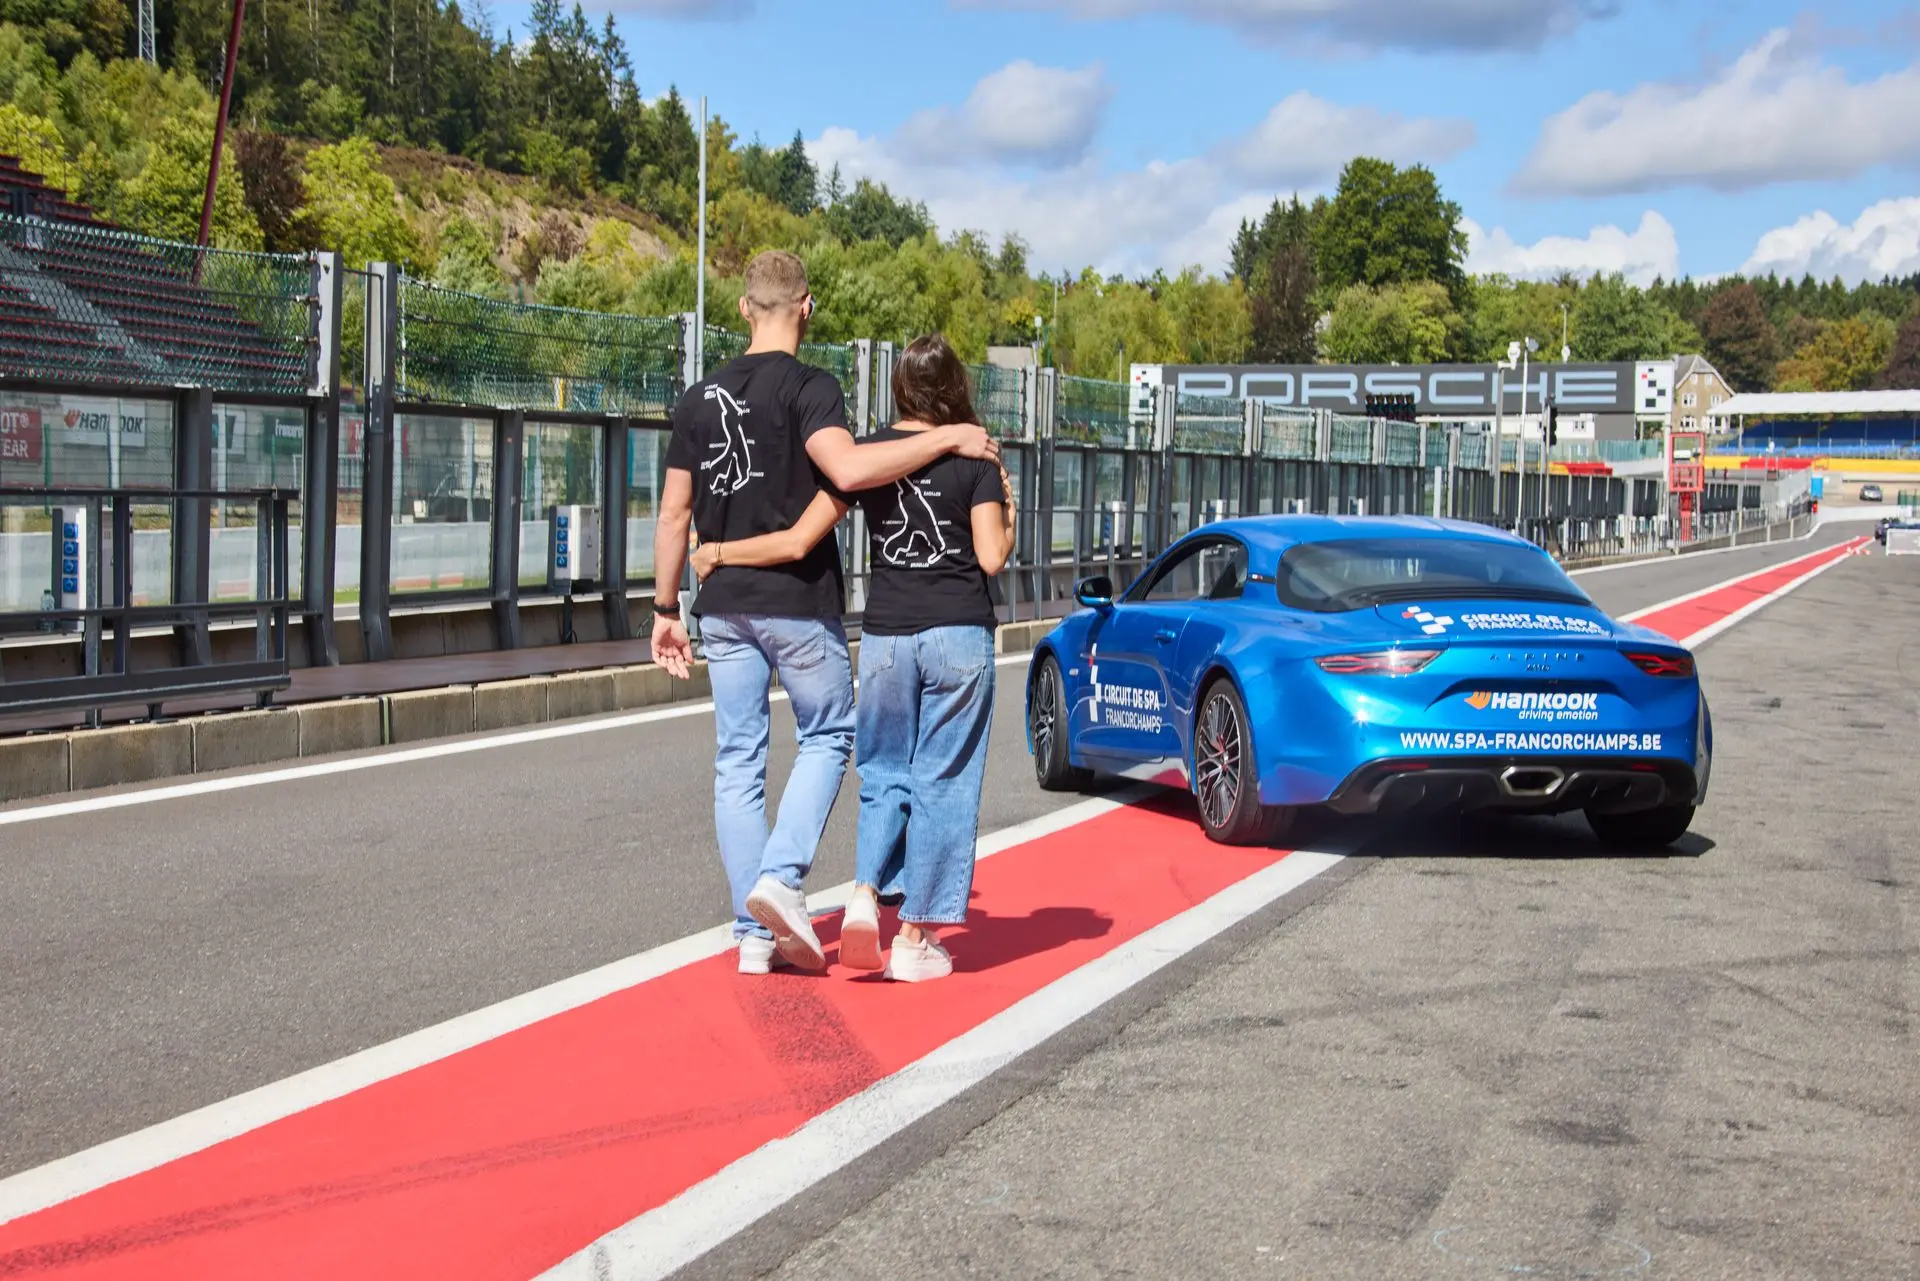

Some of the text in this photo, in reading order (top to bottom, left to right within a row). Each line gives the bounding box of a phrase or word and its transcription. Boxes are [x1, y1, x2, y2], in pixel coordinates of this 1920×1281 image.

[1178, 370, 1617, 405] PORSCHE
[80, 412, 143, 434] Hanook
[0, 438, 28, 459] EAR
[1461, 613, 1601, 630] CIRCUIT DE SPA
[1490, 652, 1585, 662] ALPINE
[1104, 684, 1160, 711] CIRCUIT DE SPA
[1105, 708, 1161, 734] FRANCORCHAMPS
[1518, 709, 1598, 721] driving emotion
[1400, 732, 1662, 750] WWW.SPA-FRANCORCHAMPS.BE
